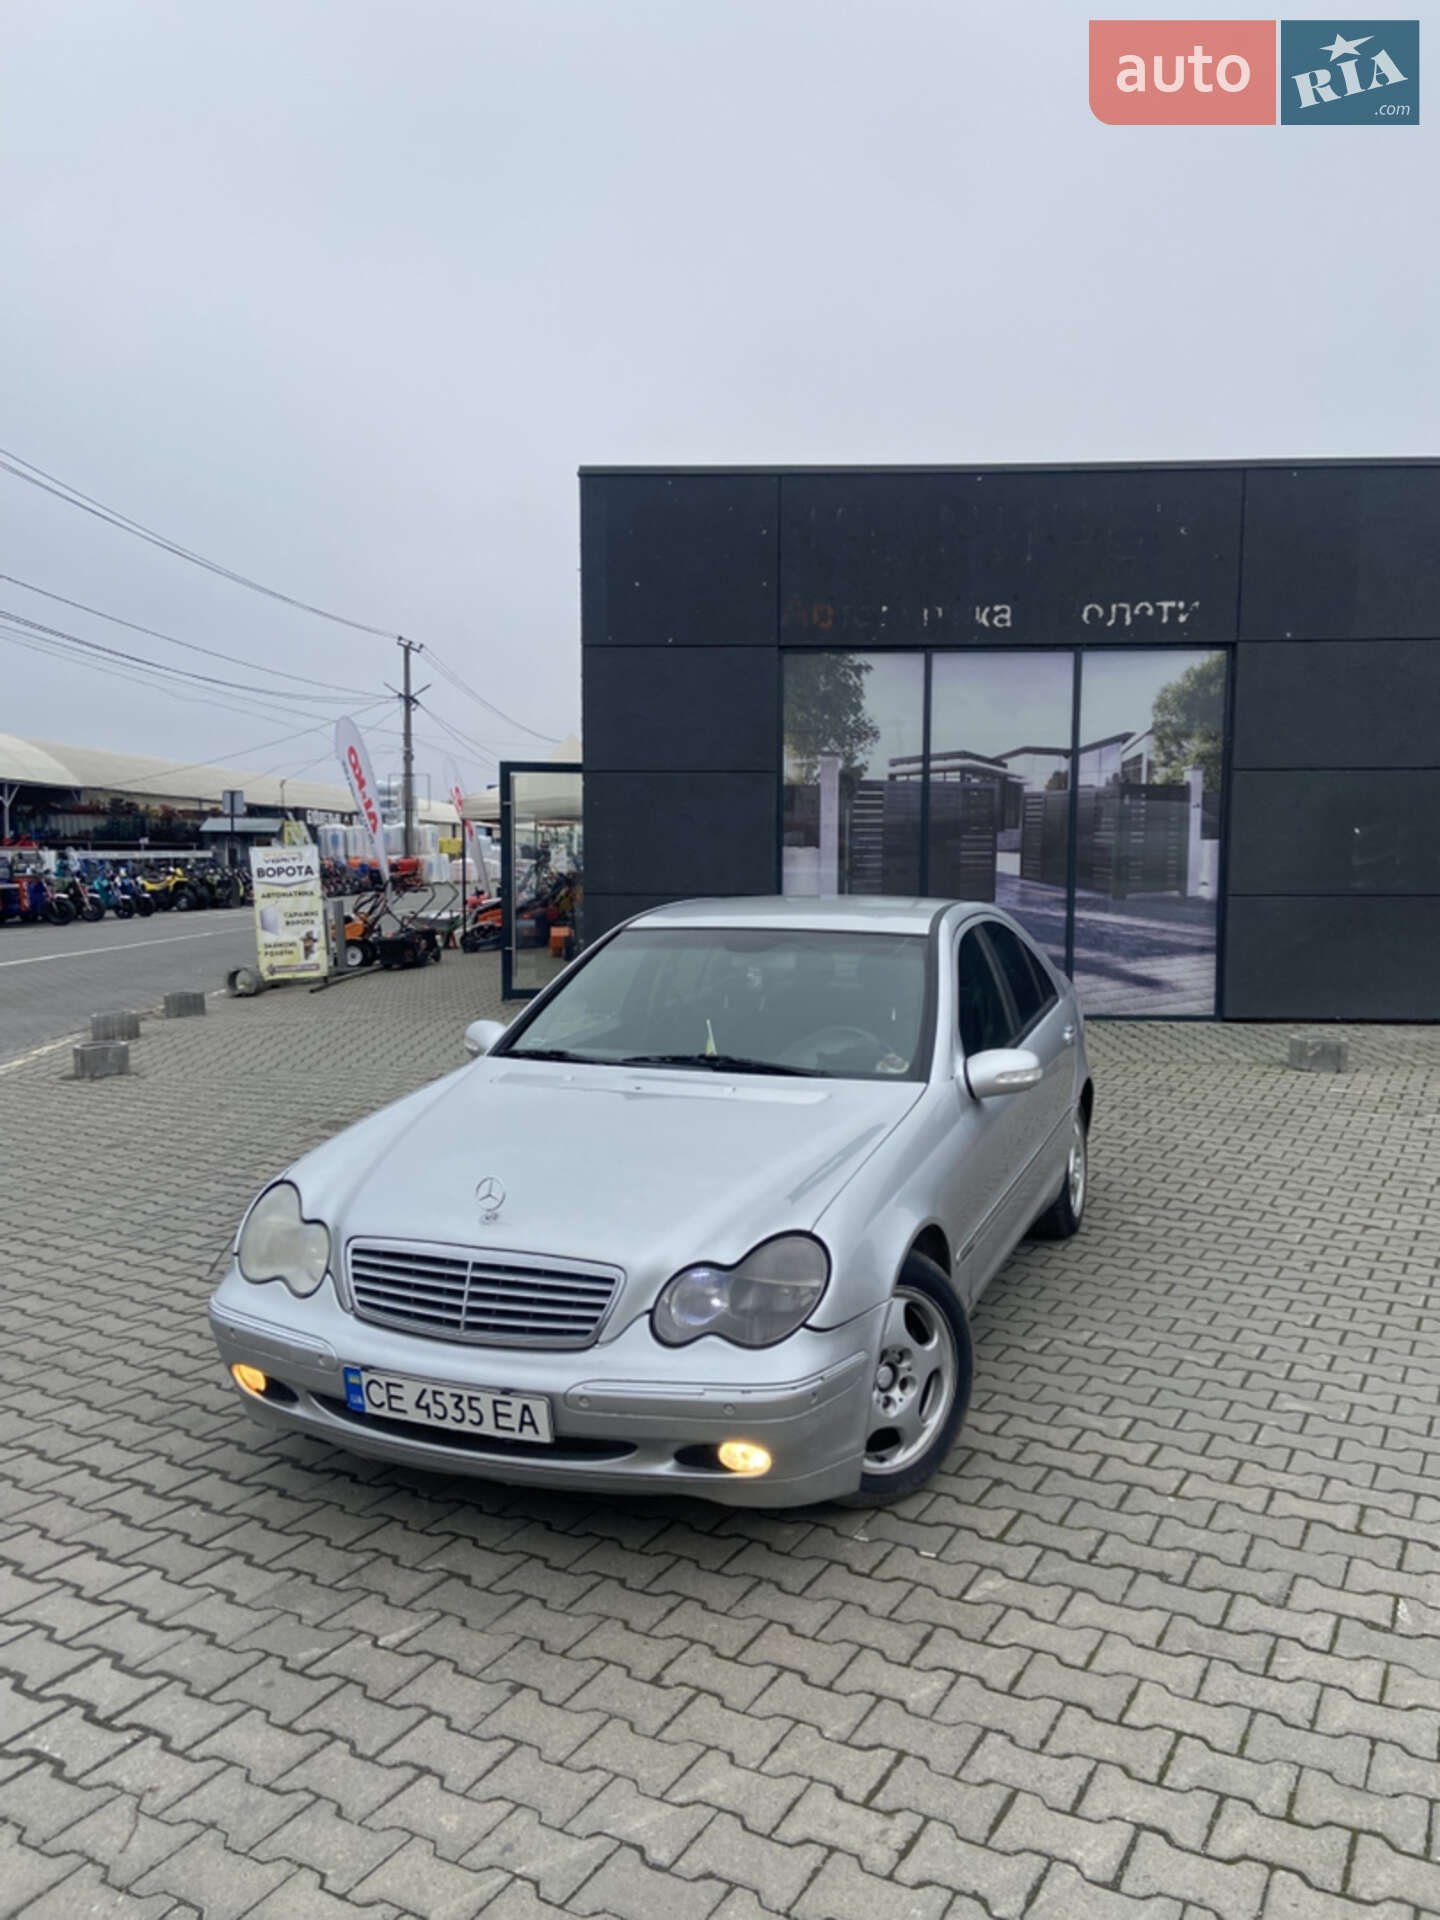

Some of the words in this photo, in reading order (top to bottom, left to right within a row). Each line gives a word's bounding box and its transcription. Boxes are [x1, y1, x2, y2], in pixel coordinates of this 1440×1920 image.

[257, 865, 315, 879] ВОРОТА
[365, 1379, 408, 1414] CE
[415, 1388, 484, 1427] 4535
[492, 1399, 540, 1436] EA
